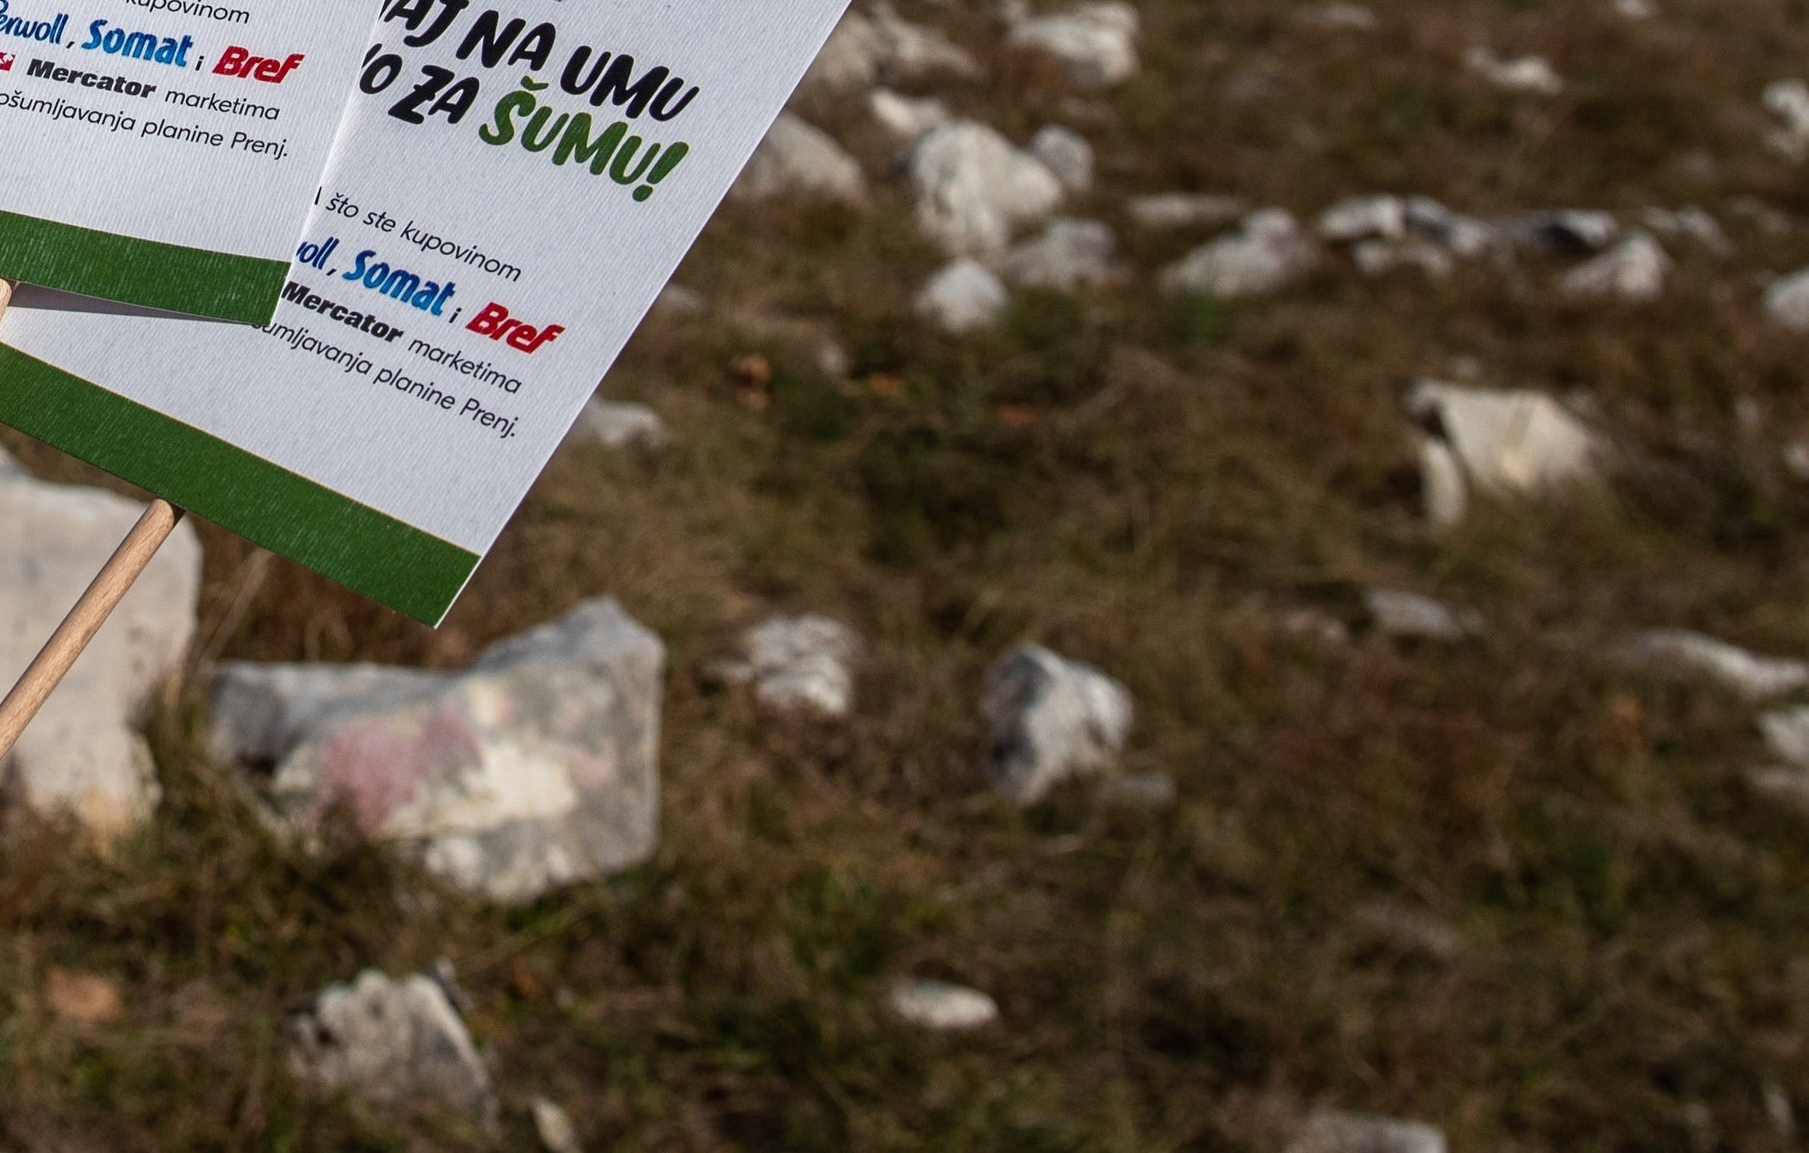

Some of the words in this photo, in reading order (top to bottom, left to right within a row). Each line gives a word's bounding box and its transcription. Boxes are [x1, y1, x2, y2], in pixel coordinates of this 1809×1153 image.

[26, 58, 157, 99] Mercator
[164, 87, 281, 121] marketima
[81, 19, 193, 68] Somat
[195, 54, 203, 71] i
[211, 45, 306, 85] Bref
[455, 9, 556, 72] NA
[560, 45, 700, 122] UMU
[141, 117, 224, 147] planine
[230, 131, 289, 161] Prenj.
[388, 64, 480, 125] ZA
[478, 75, 689, 202] ŠUMU!
[325, 192, 359, 218] što
[363, 211, 396, 233] ste
[400, 220, 521, 282] kupovinom
[281, 280, 404, 343] Mercator
[408, 337, 522, 394] marketima
[341, 249, 456, 316] Somat
[448, 308, 462, 323] i
[464, 301, 566, 354] Bref
[373, 364, 455, 411] planine
[459, 398, 518, 440] Prenj.
